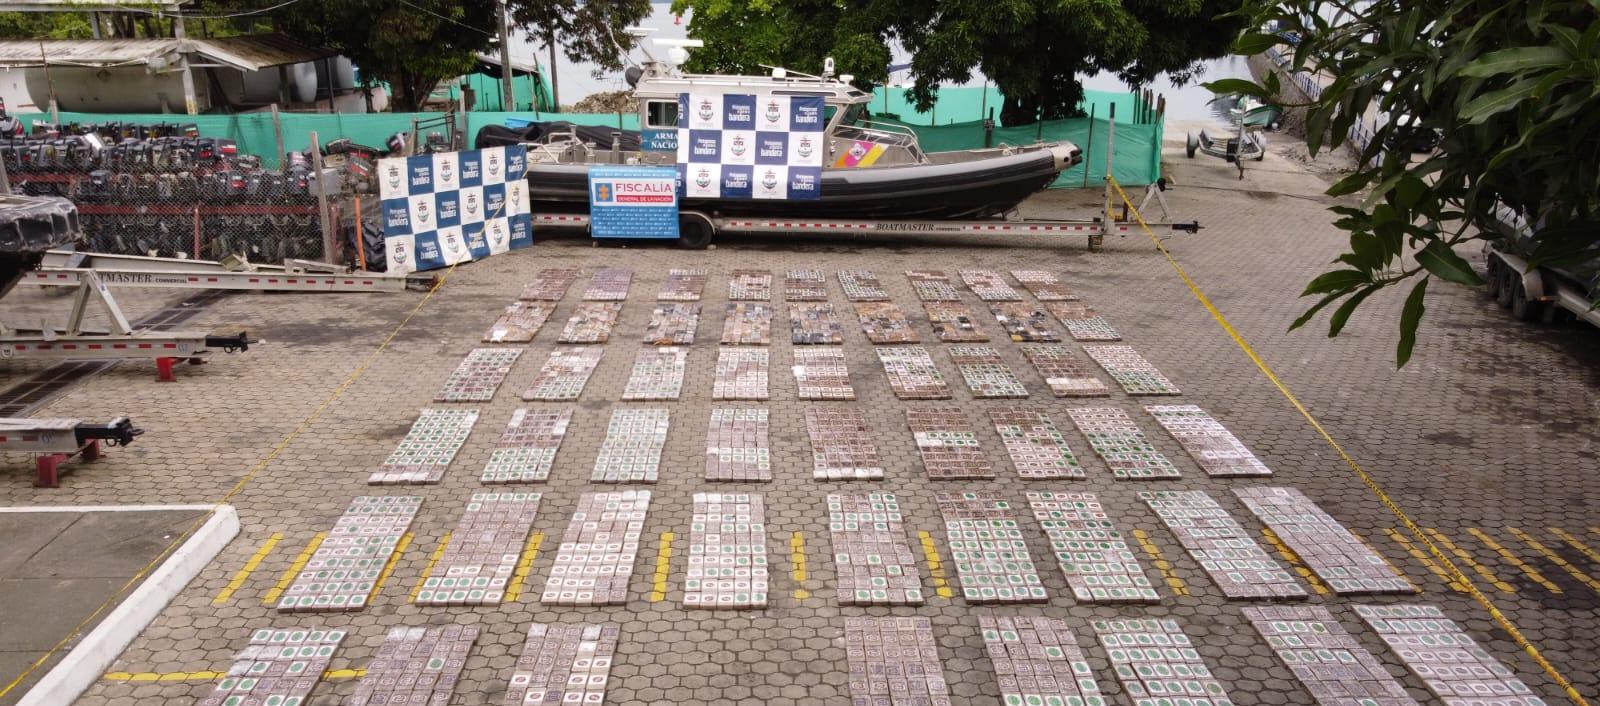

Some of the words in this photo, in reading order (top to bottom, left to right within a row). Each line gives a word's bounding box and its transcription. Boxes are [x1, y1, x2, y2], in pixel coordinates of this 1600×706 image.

[728, 112, 750, 121] bandera
[795, 114, 817, 123] bandera
[694, 146, 716, 155] bandera
[760, 148, 783, 157] bandera
[615, 181, 672, 192] FISCALÍA
[725, 180, 747, 188] bandera
[792, 182, 814, 191] bandera
[877, 223, 935, 232] BOATMASTER
